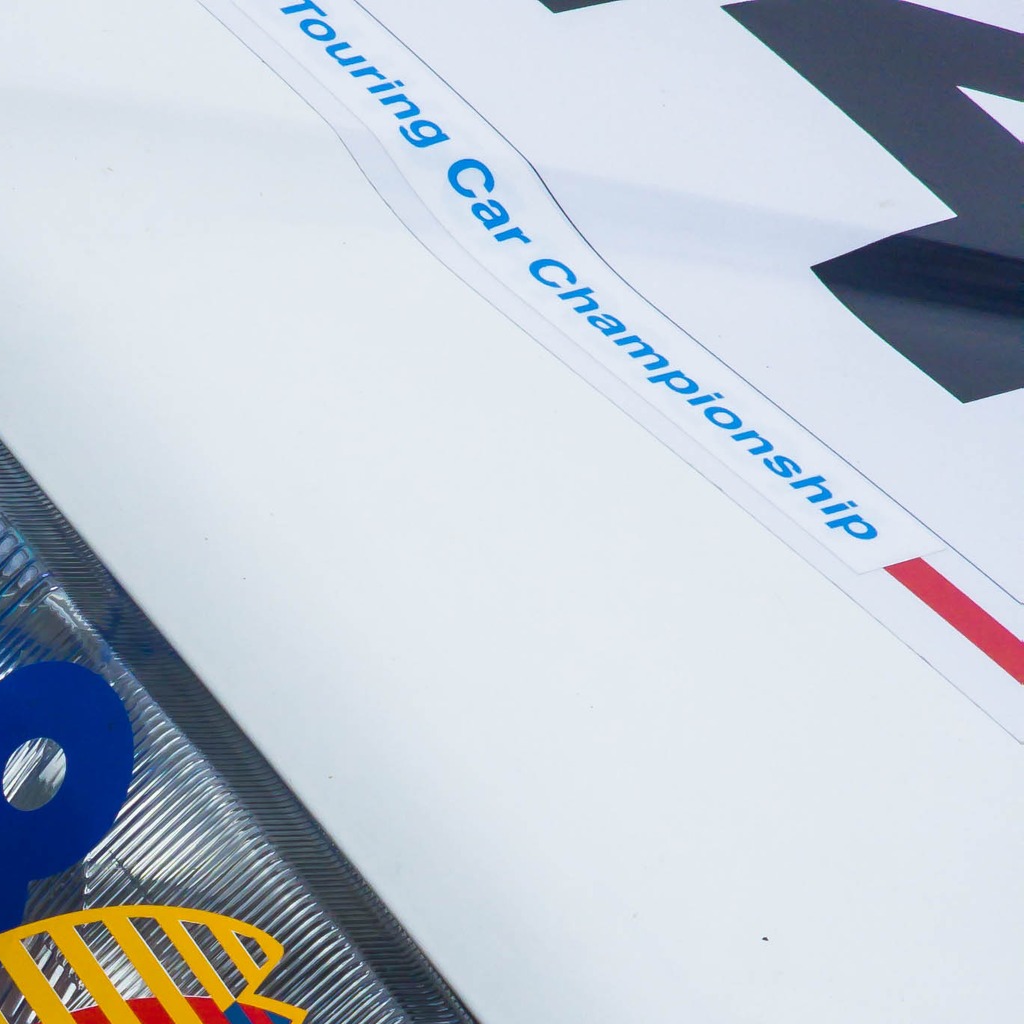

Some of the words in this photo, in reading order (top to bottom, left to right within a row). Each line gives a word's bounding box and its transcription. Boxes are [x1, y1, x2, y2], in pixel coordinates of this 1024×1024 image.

[279, 0, 451, 149] Touring
[445, 157, 533, 247] Car
[527, 256, 879, 542] Championship
